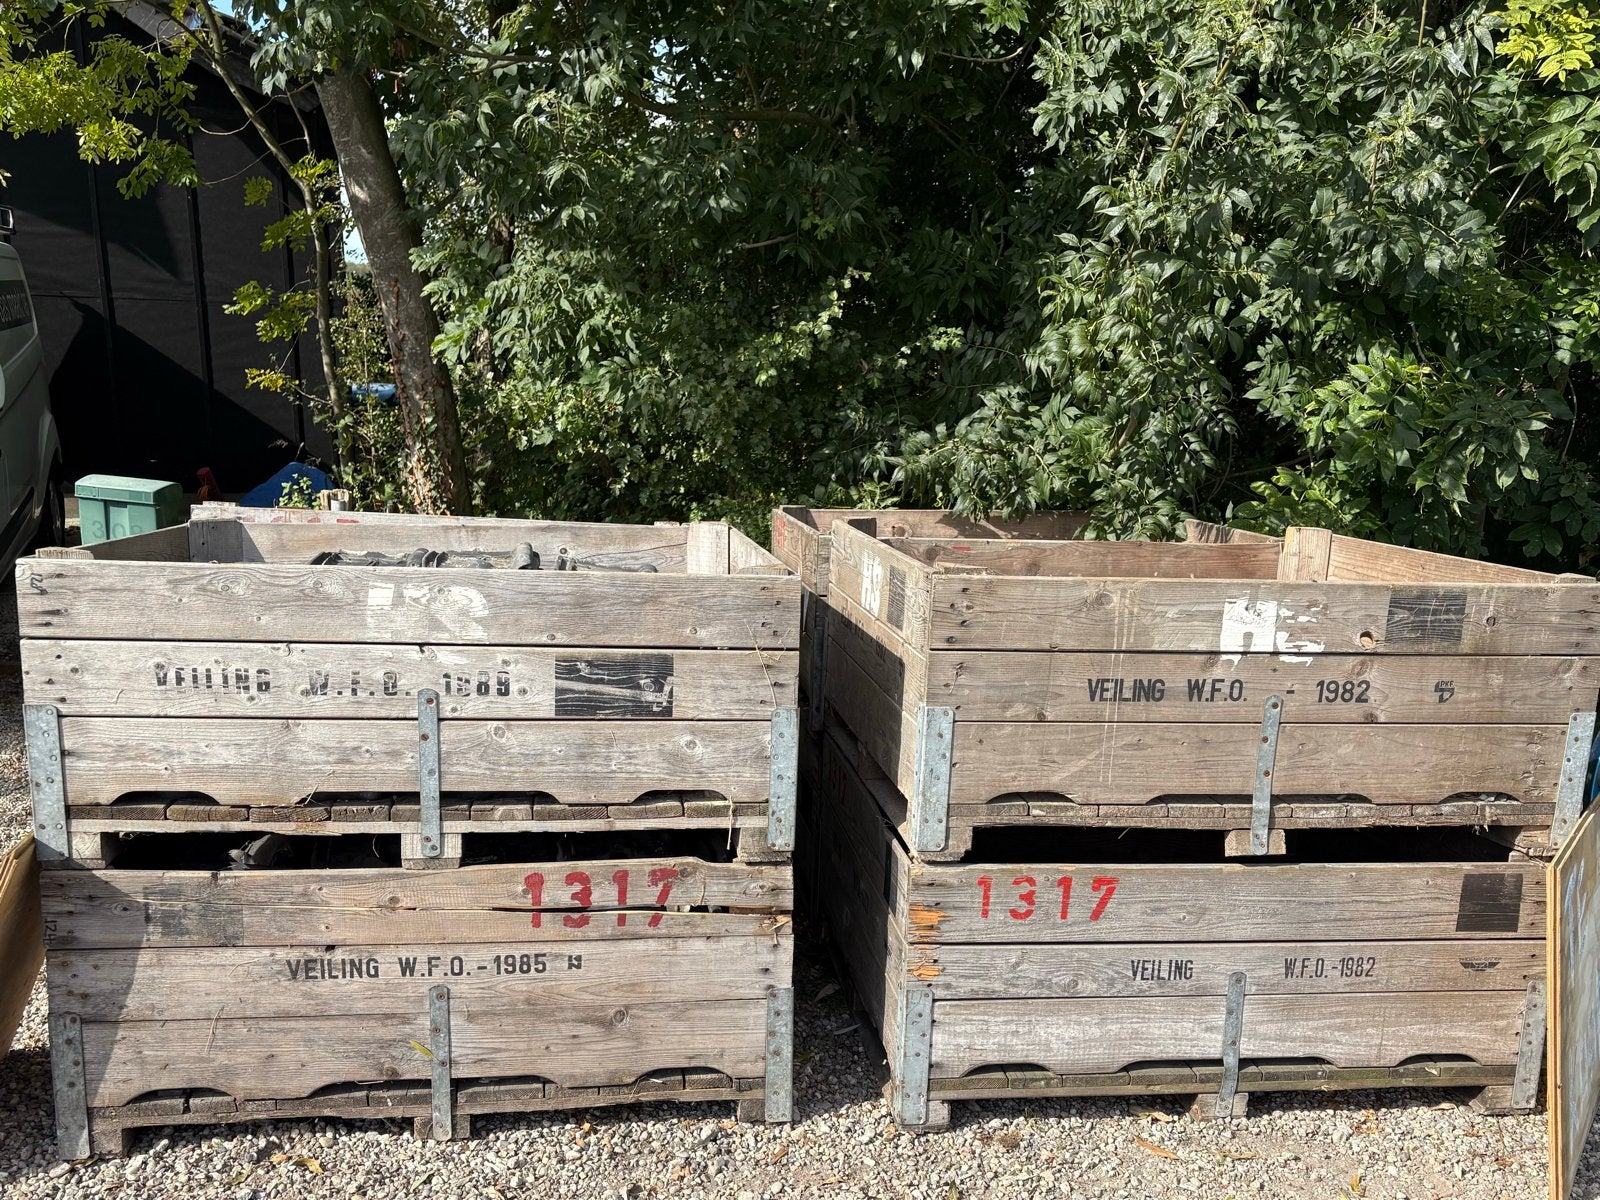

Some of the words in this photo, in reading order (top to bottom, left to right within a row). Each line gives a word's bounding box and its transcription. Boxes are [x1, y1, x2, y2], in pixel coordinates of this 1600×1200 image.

[1087, 678, 1166, 702] VEILING
[1187, 678, 1247, 702] W.F.O.
[1315, 679, 1371, 703] 1982
[524, 868, 680, 928] 1317
[977, 875, 1120, 922] 1317
[284, 958, 379, 980] VEILING
[1130, 959, 1193, 981] VEILING
